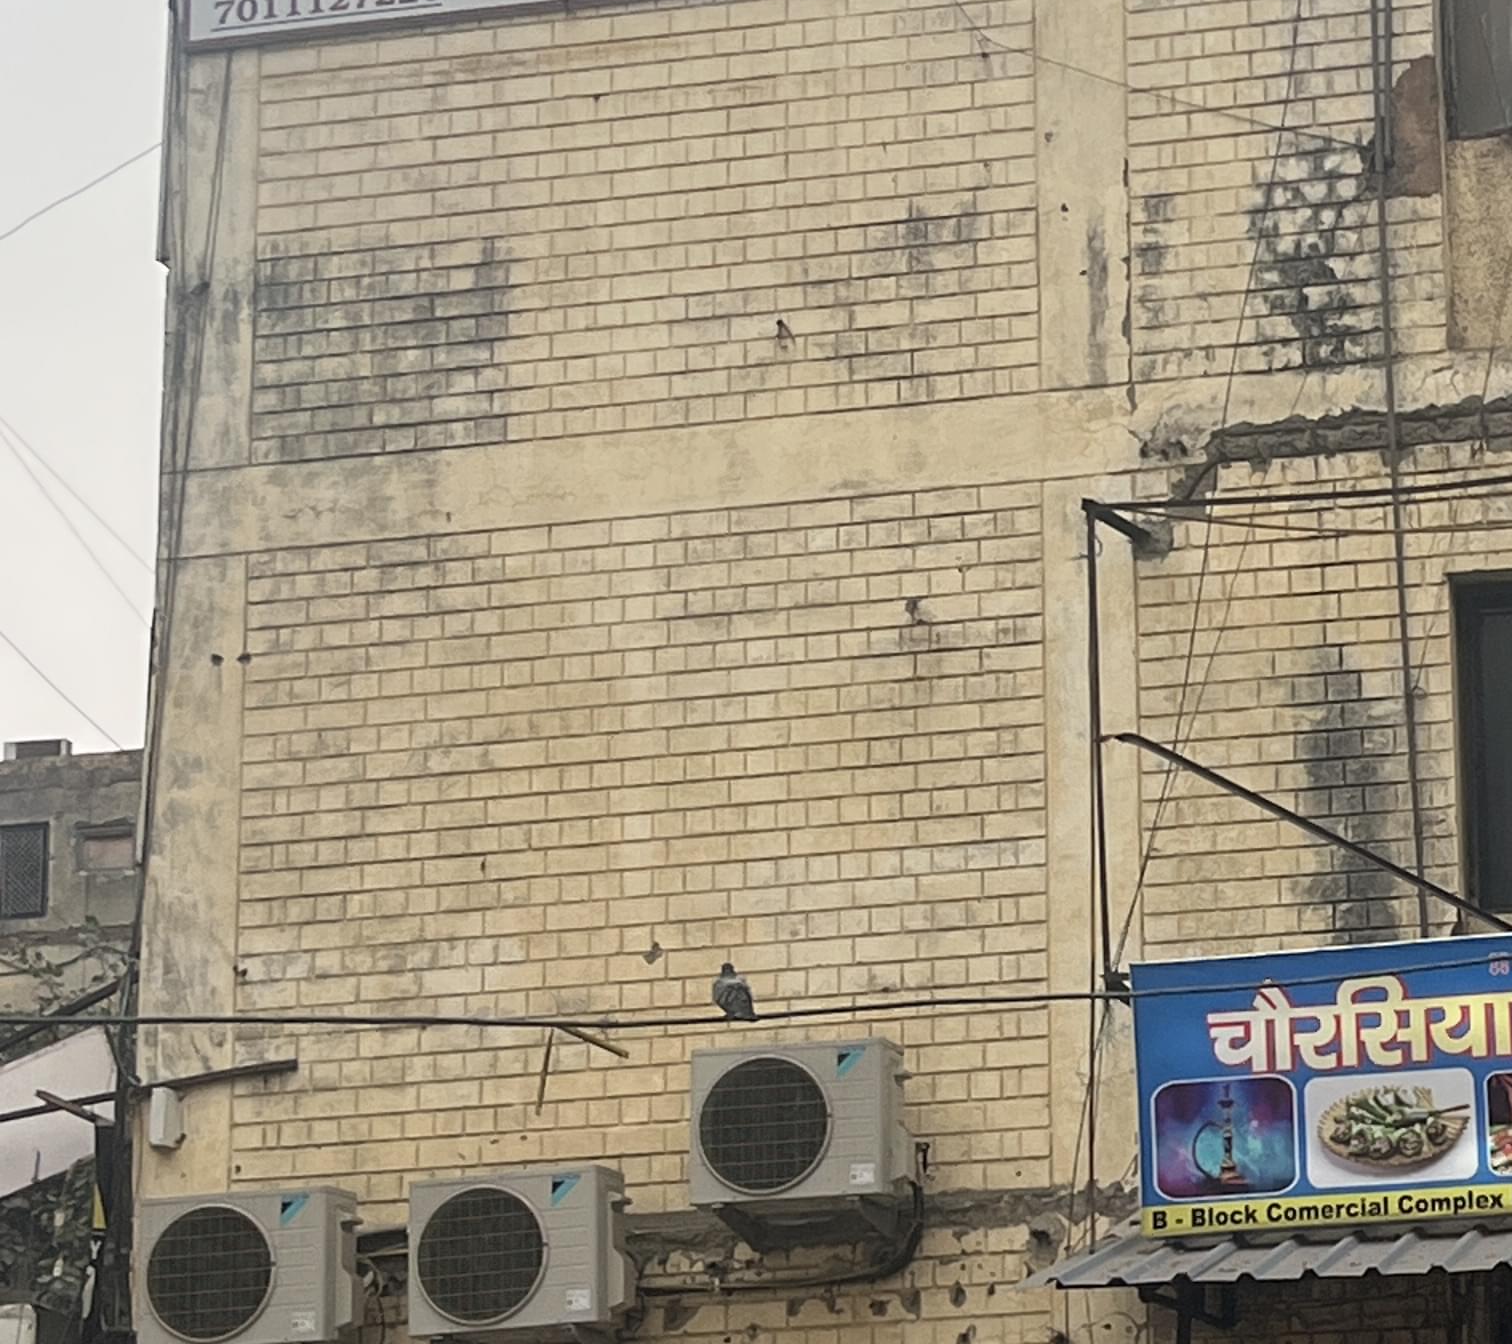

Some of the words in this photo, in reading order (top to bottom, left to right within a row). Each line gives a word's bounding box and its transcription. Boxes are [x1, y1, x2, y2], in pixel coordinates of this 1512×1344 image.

[1152, 1209, 1167, 1227] B
[1190, 1200, 1259, 1224] Block
[1265, 1195, 1391, 1221] Comercial
[1397, 1187, 1503, 1221] Complex
